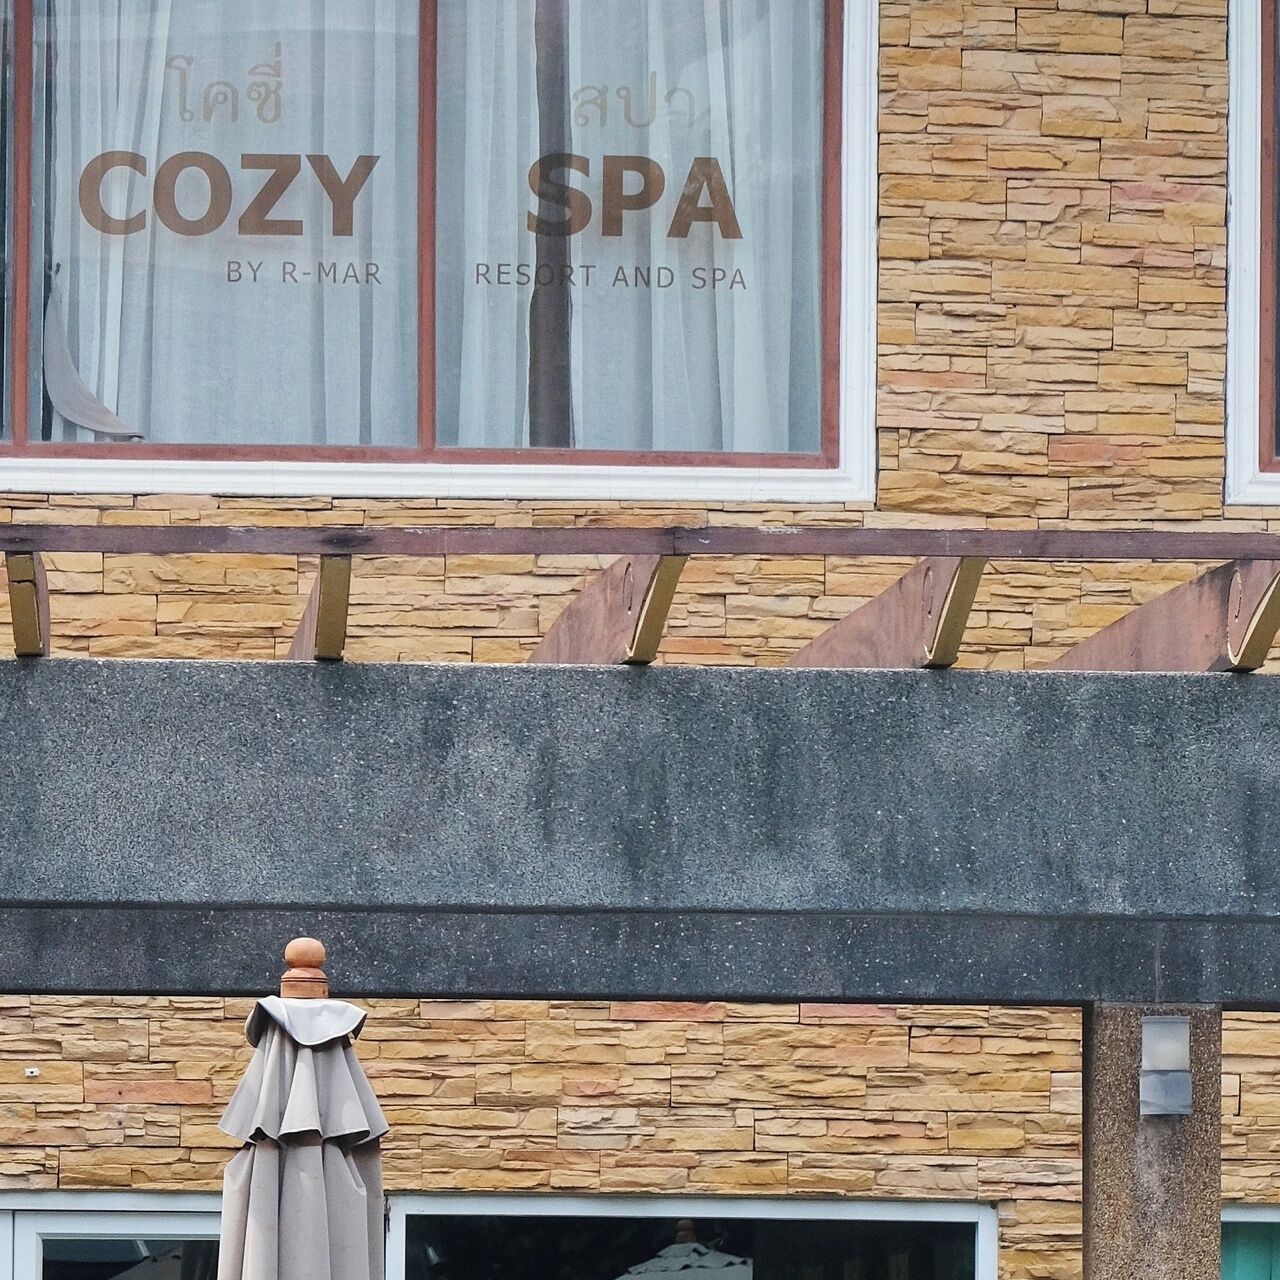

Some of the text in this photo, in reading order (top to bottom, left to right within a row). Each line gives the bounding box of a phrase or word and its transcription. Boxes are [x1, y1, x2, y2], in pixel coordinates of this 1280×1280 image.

[166, 40, 283, 124] โคซี่
[572, 70, 697, 129] สปา
[77, 149, 382, 237] COZY
[526, 152, 744, 240] SPA
[226, 260, 748, 291] BY R-MAR RESORT AND SPA
